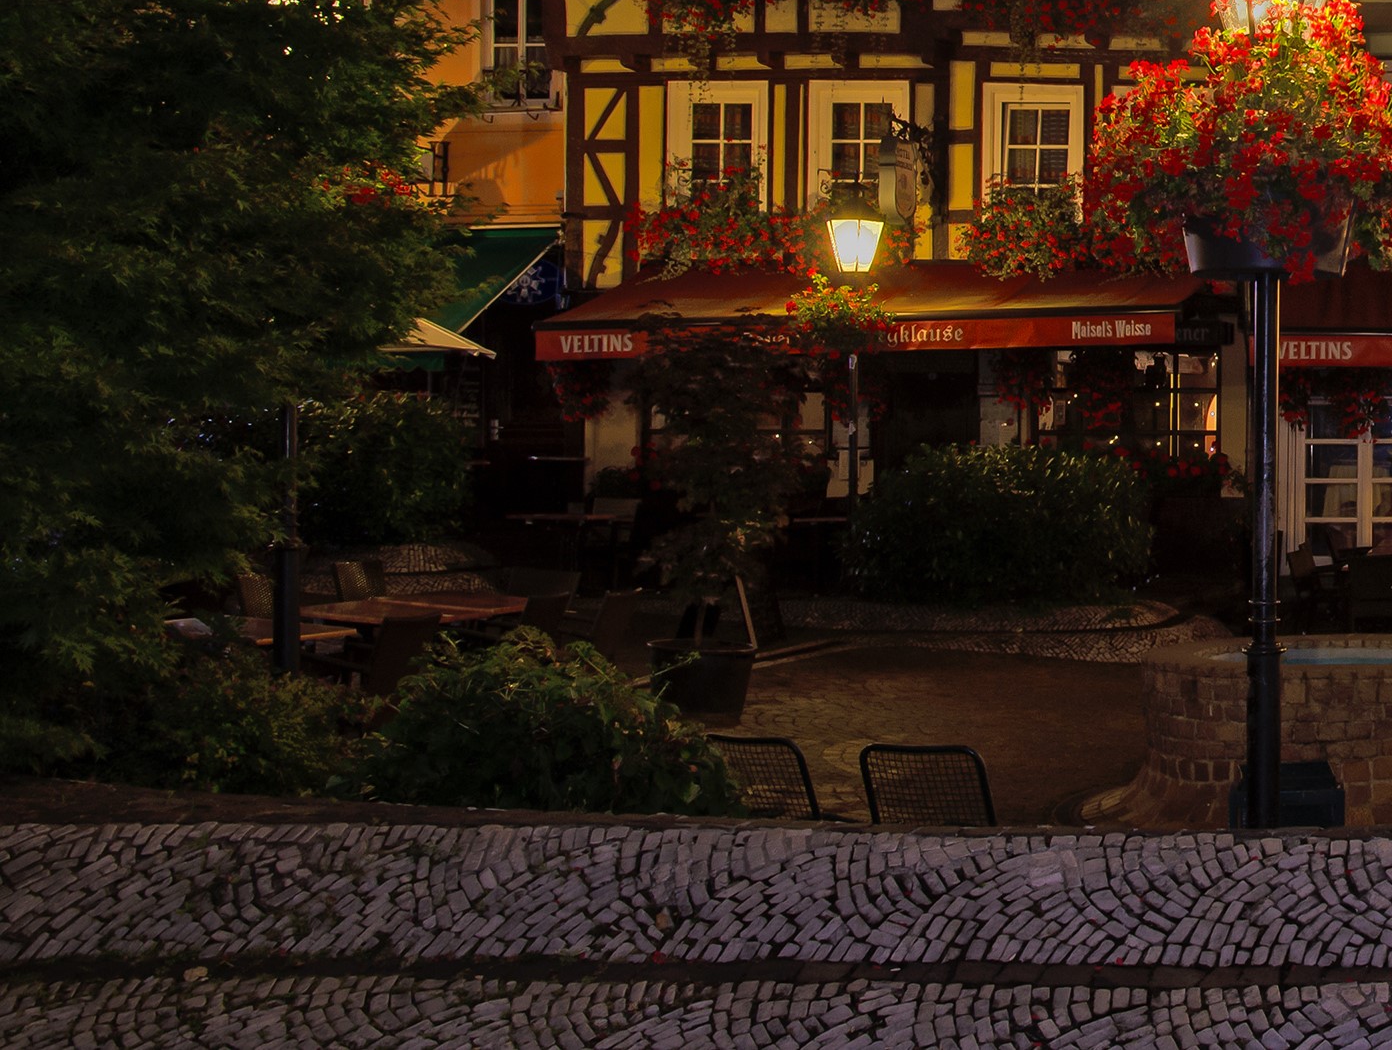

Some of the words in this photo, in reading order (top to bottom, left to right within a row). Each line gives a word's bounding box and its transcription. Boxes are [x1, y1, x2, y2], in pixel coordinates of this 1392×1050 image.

[1071, 321, 1112, 340] Maisel's
[1115, 320, 1151, 338] Weisse
[559, 334, 633, 354] VELTINS
